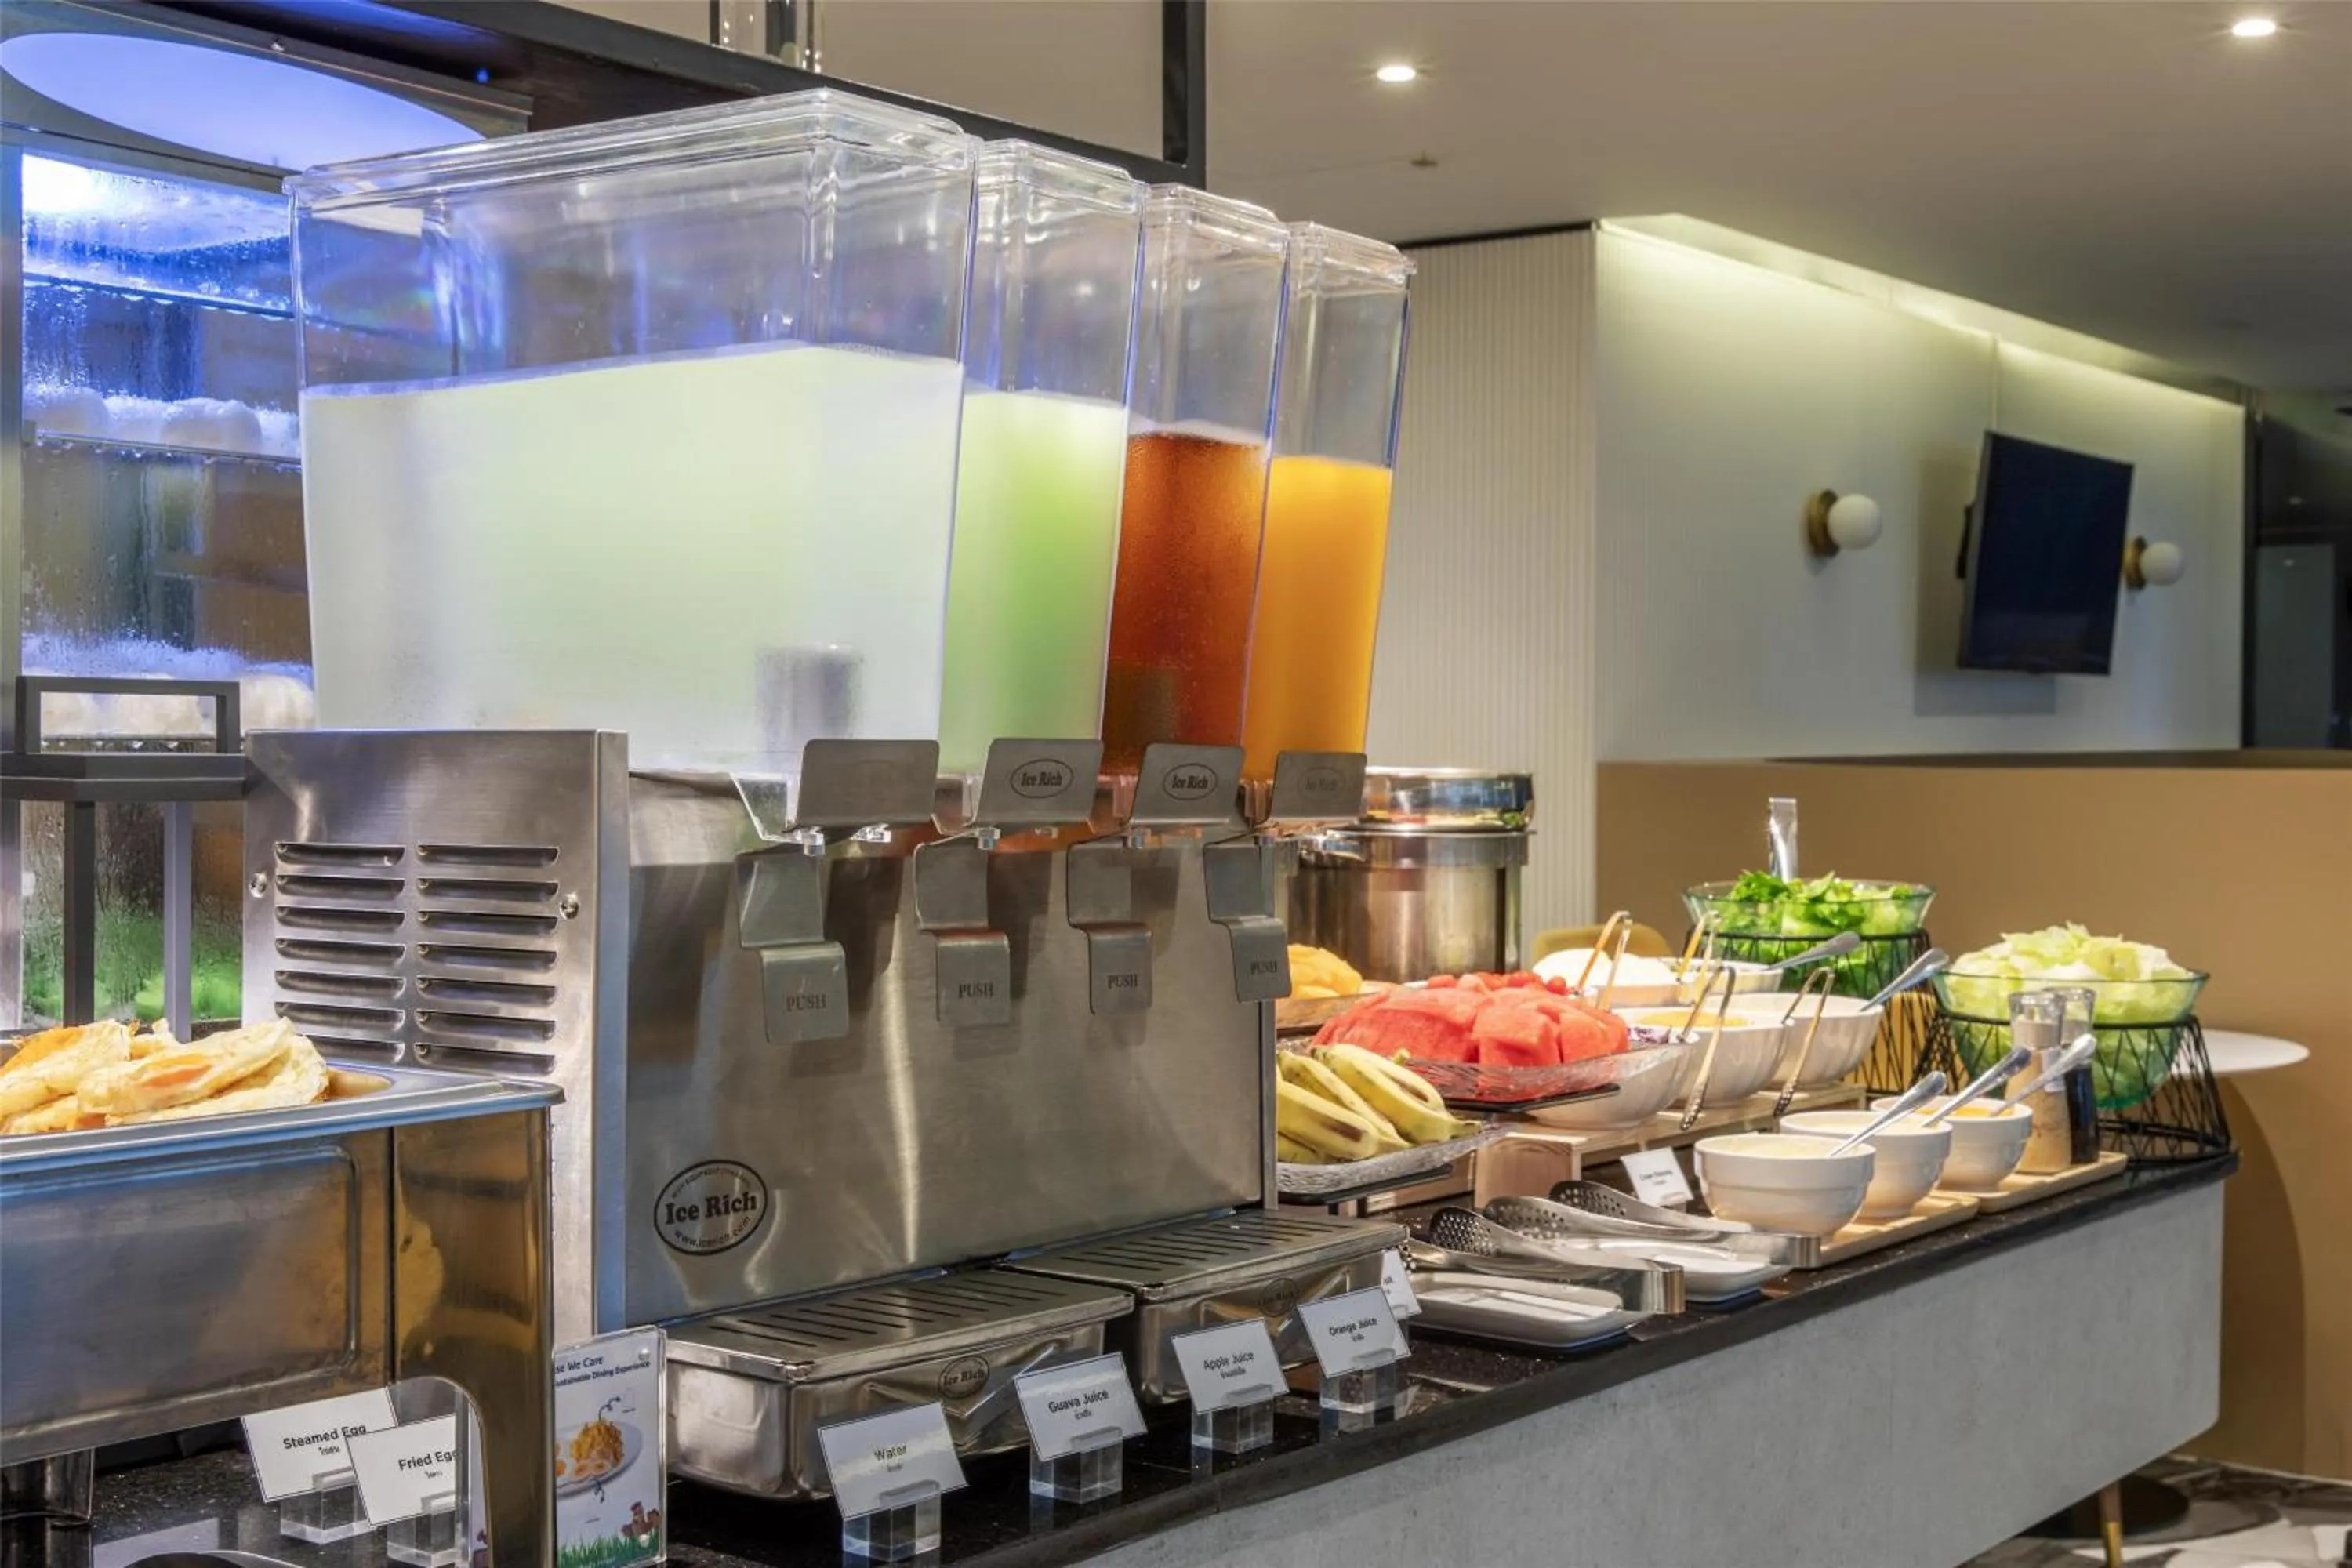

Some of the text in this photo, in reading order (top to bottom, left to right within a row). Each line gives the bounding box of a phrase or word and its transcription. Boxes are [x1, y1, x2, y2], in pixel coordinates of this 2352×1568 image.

[1039, 771, 1062, 786] Rich
[1187, 775, 1208, 789] Rich
[1250, 960, 1278, 975] PUSH
[1107, 974, 1138, 989] PUSH
[958, 982, 994, 999] PUSH
[786, 993, 827, 1012] PUSH
[665, 1191, 757, 1225] Ice Rich
[1329, 1318, 1377, 1336] Orange Juice
[567, 1361, 581, 1371] We
[583, 1356, 603, 1368] Care
[1203, 1352, 1254, 1370] Apple Juice
[592, 1369, 614, 1379] Dining
[1047, 1390, 1109, 1413] Guava Juice
[283, 1425, 366, 1450] Steamed Egg
[398, 1452, 432, 1471] Fried
[874, 1445, 907, 1461] Water
